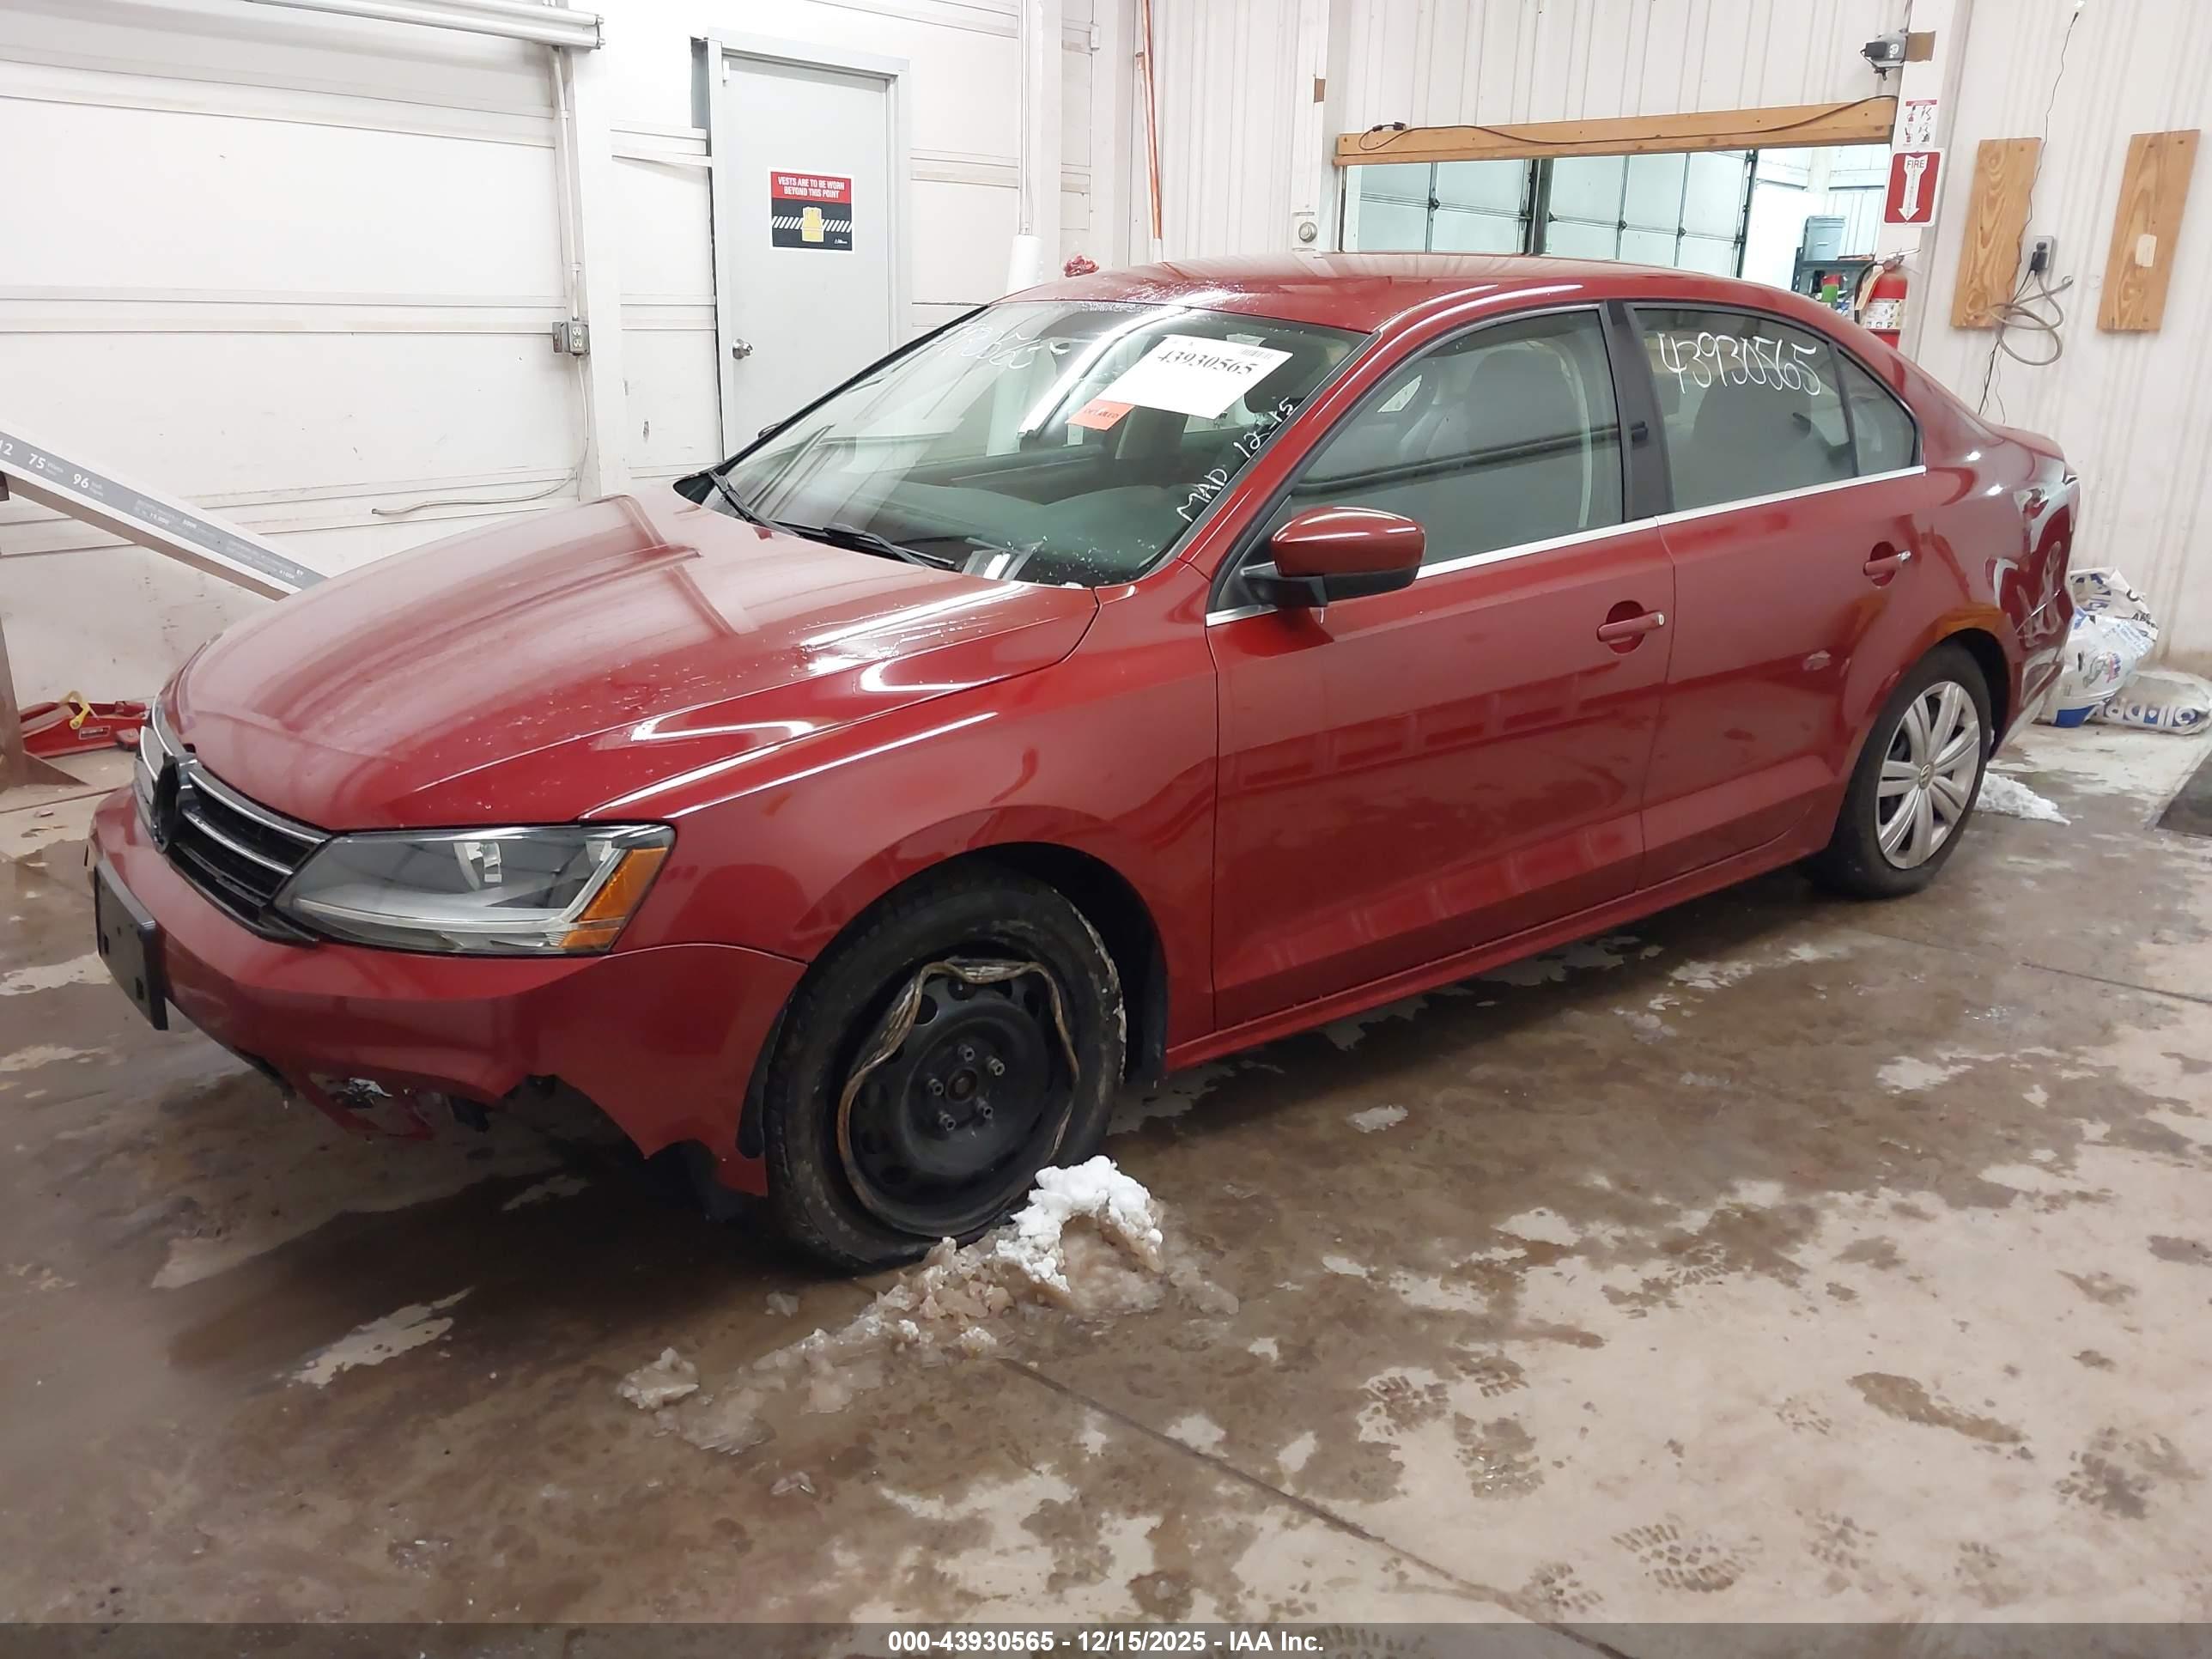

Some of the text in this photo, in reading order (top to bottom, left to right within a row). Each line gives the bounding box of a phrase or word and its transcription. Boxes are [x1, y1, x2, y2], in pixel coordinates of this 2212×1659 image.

[1906, 159, 1924, 169] FIRE
[778, 176, 845, 191] VESTS ARE TO BE WORN
[784, 185, 840, 198] BEYOND THIS POINT
[1158, 349, 1259, 375] 43930565
[1657, 331, 1821, 396] 43930565
[28, 453, 46, 470] 75
[73, 473, 89, 489] 96
[1176, 468, 1228, 523] MAD
